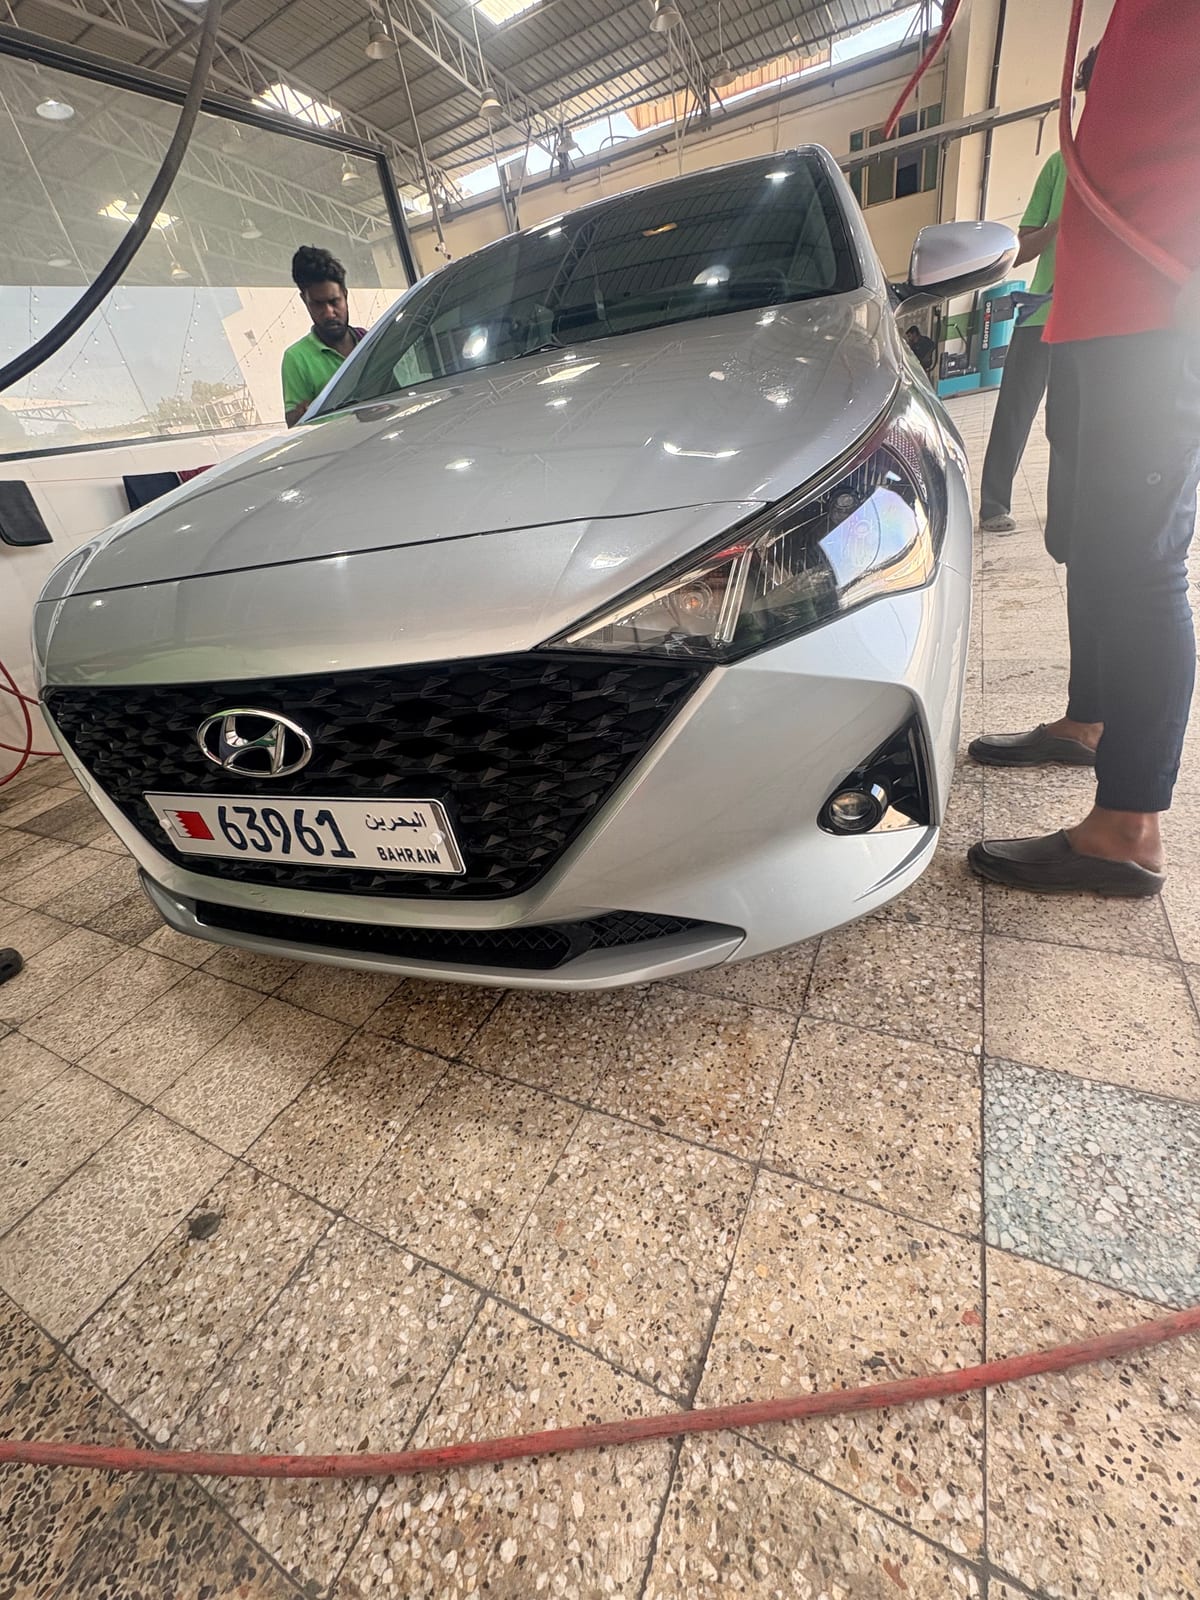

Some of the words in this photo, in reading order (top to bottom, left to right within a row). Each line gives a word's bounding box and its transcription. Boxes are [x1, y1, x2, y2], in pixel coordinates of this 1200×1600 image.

[217, 805, 357, 859] 63961
[365, 811, 428, 832] البحرين
[376, 846, 441, 864] BAHRAIN
